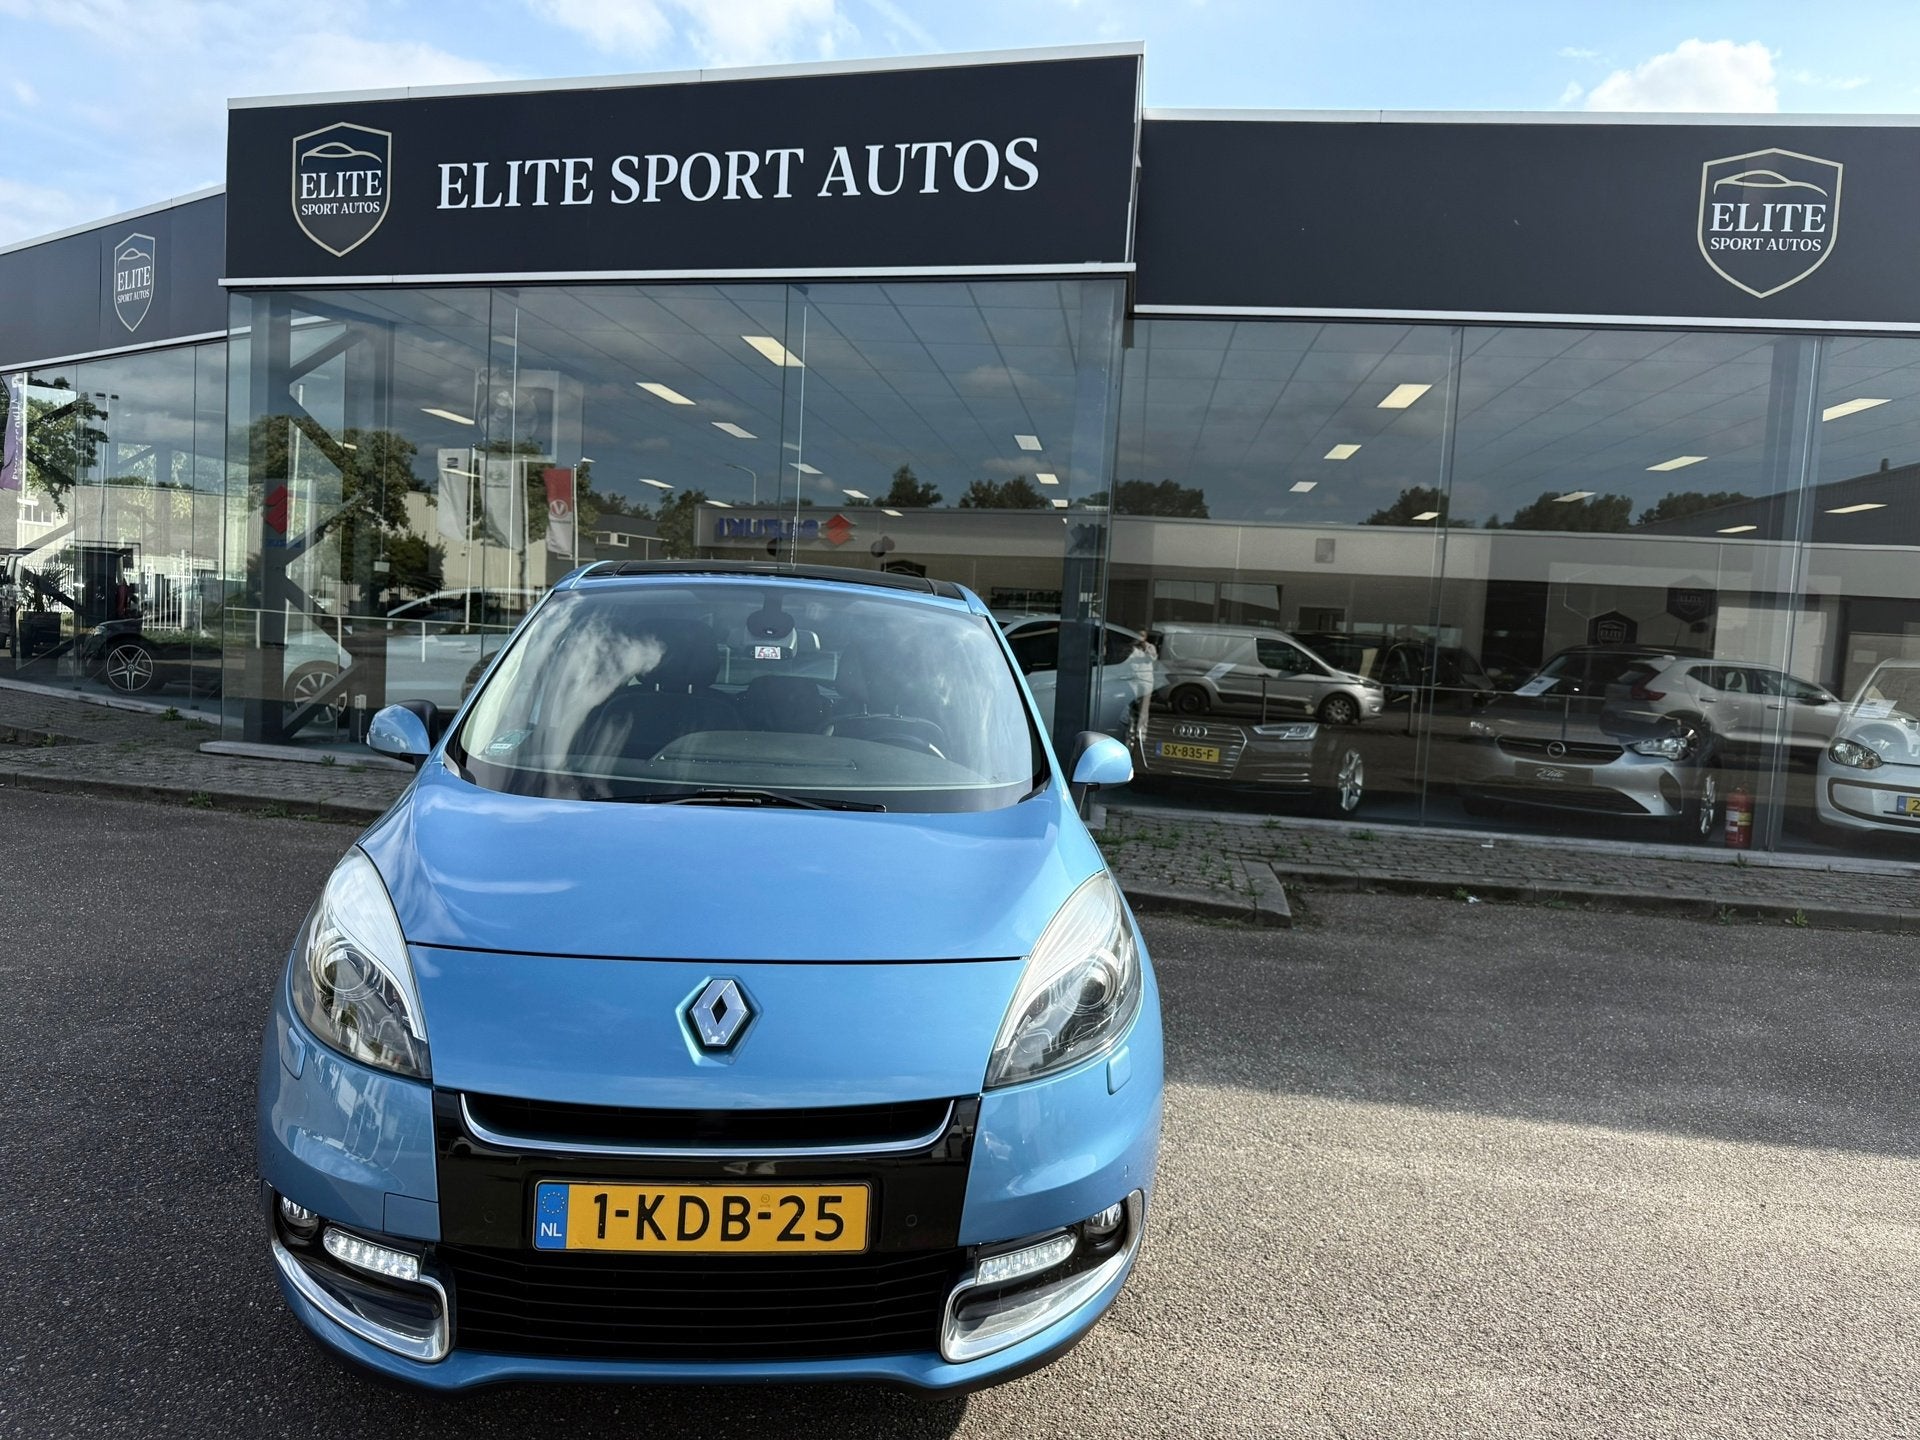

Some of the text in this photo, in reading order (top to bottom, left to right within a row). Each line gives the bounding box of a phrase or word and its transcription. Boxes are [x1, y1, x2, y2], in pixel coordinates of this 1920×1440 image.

[300, 170, 382, 199] ELITE
[436, 137, 1040, 210] ELITE SPORT AUTOS
[301, 201, 380, 216] SPORT AUTOS
[1709, 203, 1827, 233] ELITE
[1710, 237, 1822, 252] SPORT AUTOS
[117, 265, 151, 292] ELITE
[117, 289, 150, 304] SPORT AUTOS
[1163, 744, 1214, 760] SX-835-F
[540, 1222, 563, 1238] NL
[593, 1192, 845, 1243] 1-KDB-25
